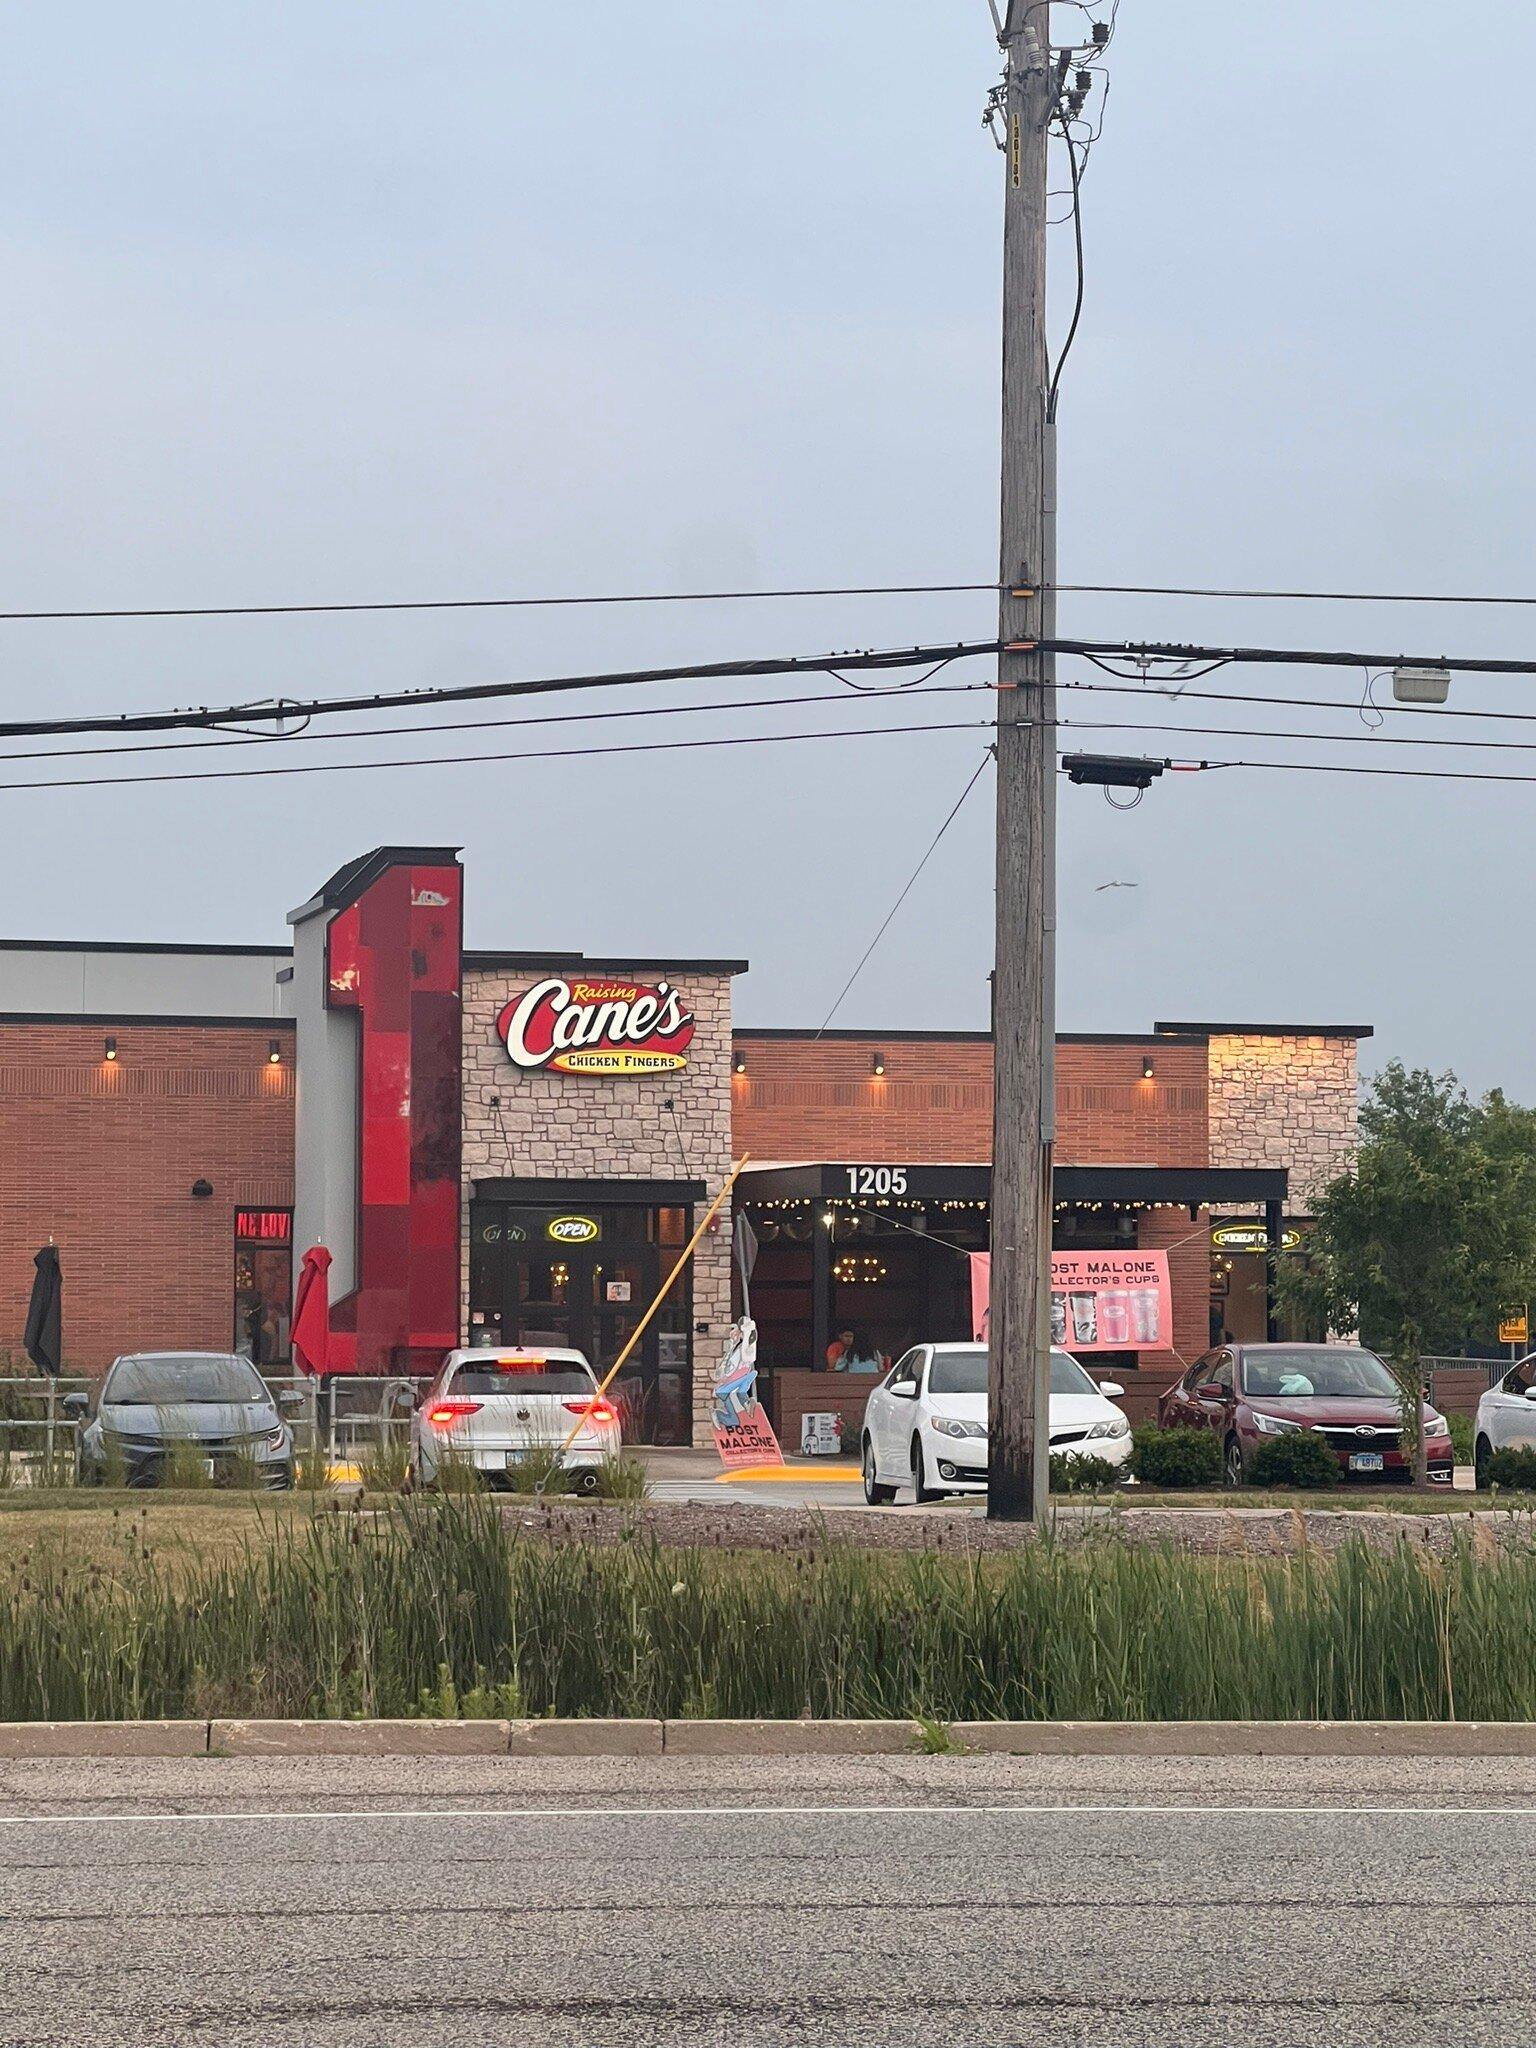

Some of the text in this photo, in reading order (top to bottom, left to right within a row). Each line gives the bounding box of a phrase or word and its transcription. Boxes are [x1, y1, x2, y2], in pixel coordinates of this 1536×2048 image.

[572, 984, 637, 1003] Raising
[507, 979, 693, 1067] Cane's
[846, 1167, 907, 1195] 1205
[554, 1222, 591, 1237] OPEN
[1051, 1262, 1156, 1274] OST MALONE
[1051, 1275, 1160, 1286] LLECTOR'S CUPS
[725, 1424, 760, 1436] POST
[720, 1437, 775, 1450] MALONE
